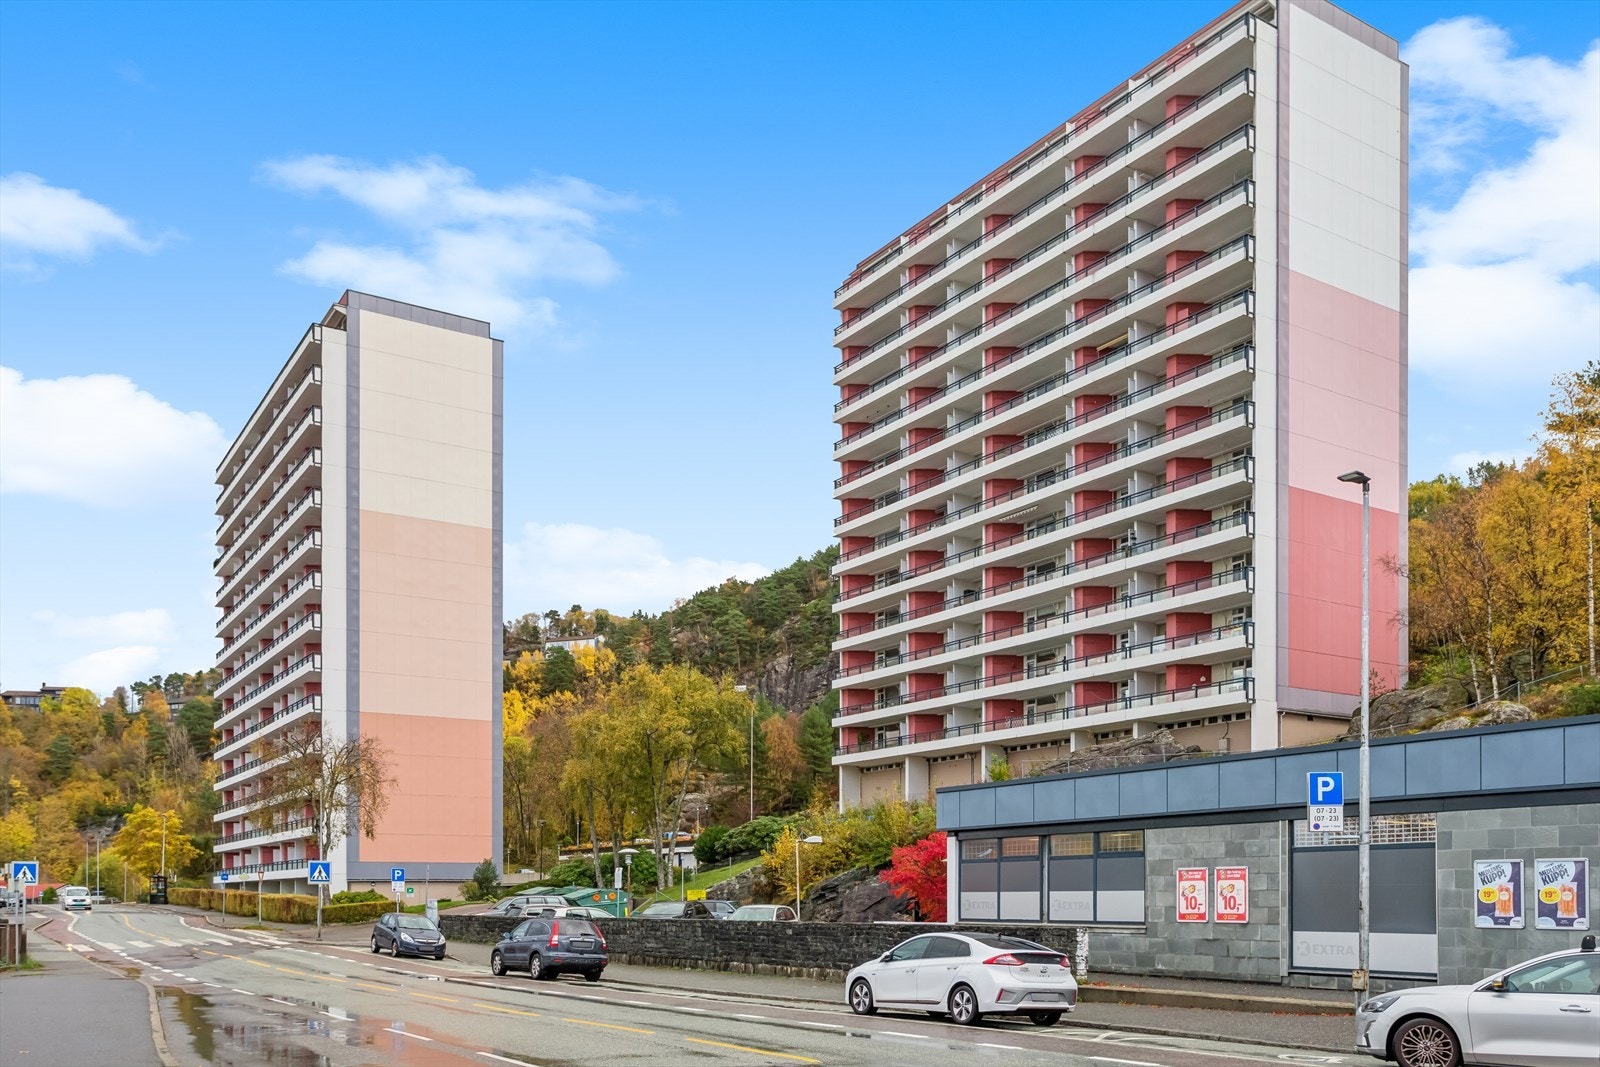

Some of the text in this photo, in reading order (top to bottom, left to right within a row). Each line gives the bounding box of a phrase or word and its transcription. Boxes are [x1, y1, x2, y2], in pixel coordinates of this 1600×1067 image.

[1317, 776, 1335, 802] P
[1480, 868, 1507, 886] KUPP!
[1541, 868, 1570, 886] KUPP!
[972, 901, 996, 911] EXTRA
[1062, 901, 1091, 911] EXTRA
[1312, 943, 1355, 956] EXTRA
